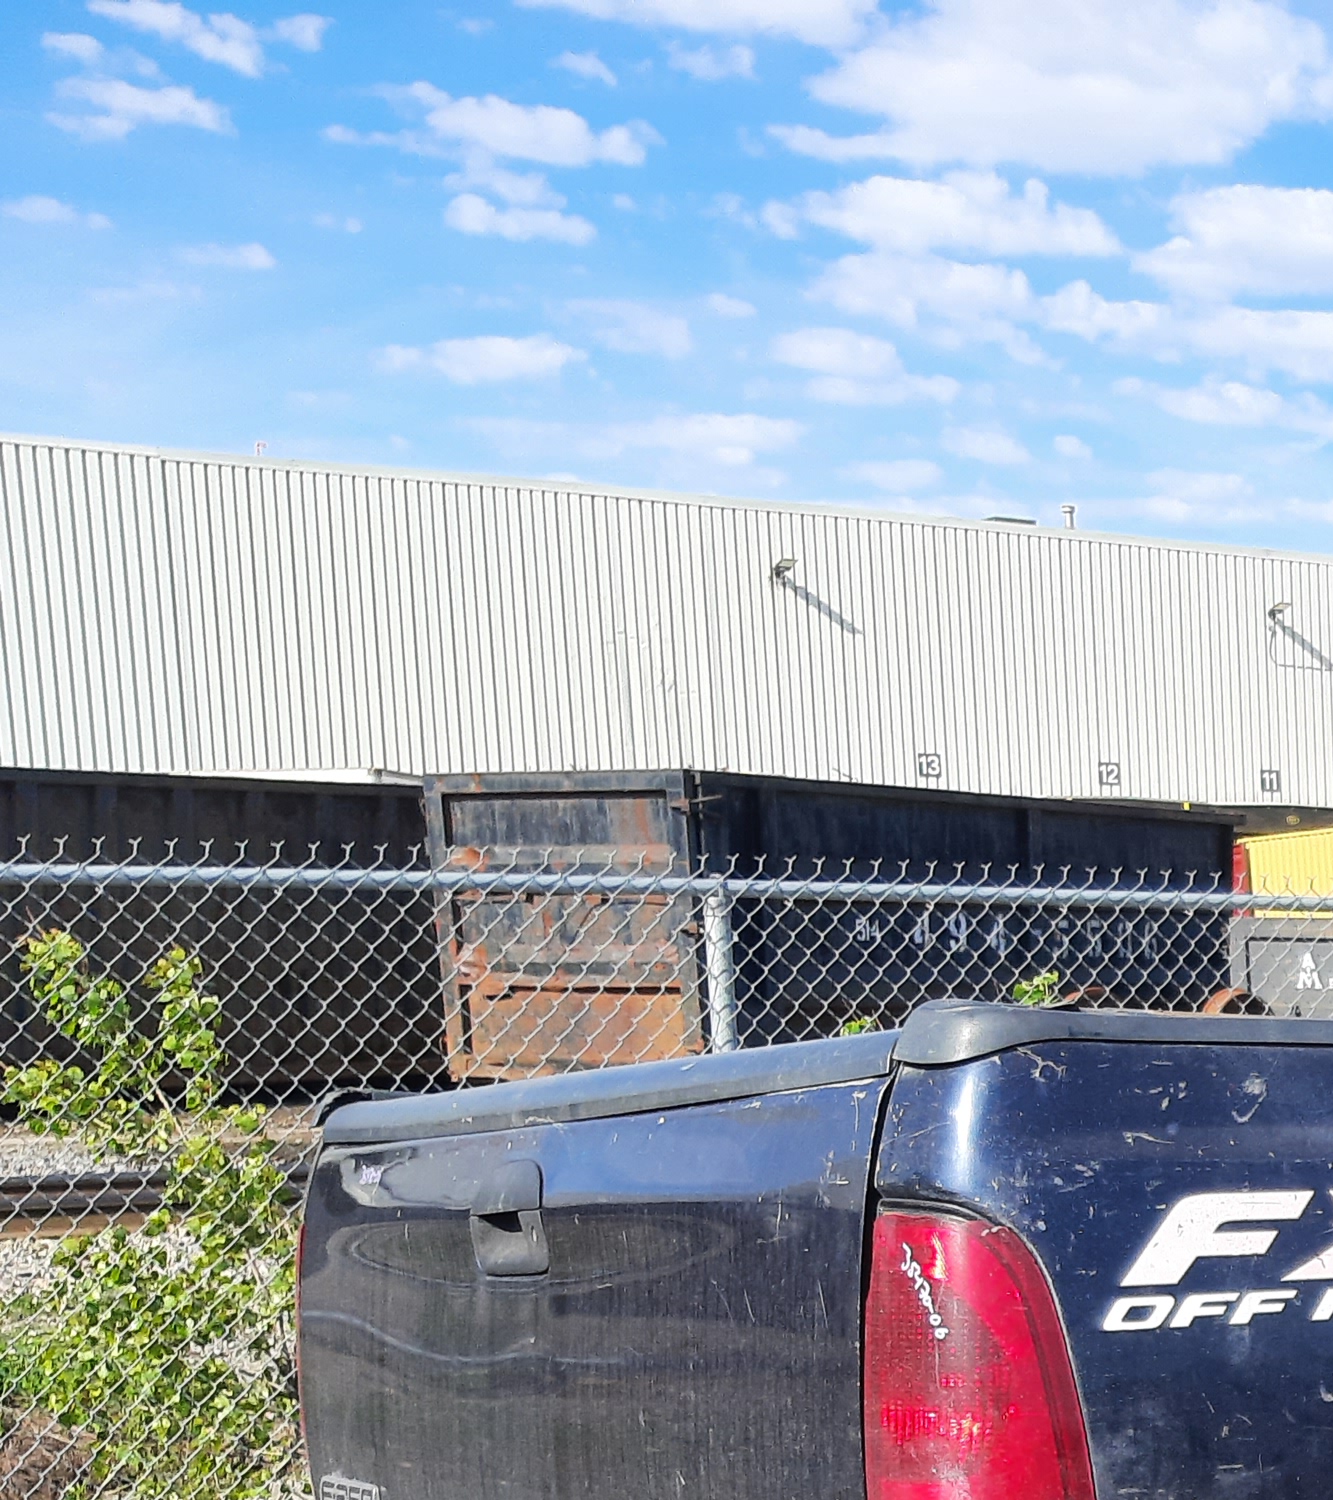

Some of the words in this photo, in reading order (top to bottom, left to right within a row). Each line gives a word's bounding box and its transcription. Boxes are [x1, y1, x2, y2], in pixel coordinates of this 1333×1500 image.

[919, 755, 941, 776] 13
[1099, 764, 1119, 784] 12
[1262, 771, 1278, 791] 11
[1102, 1289, 1299, 1332] OFF
